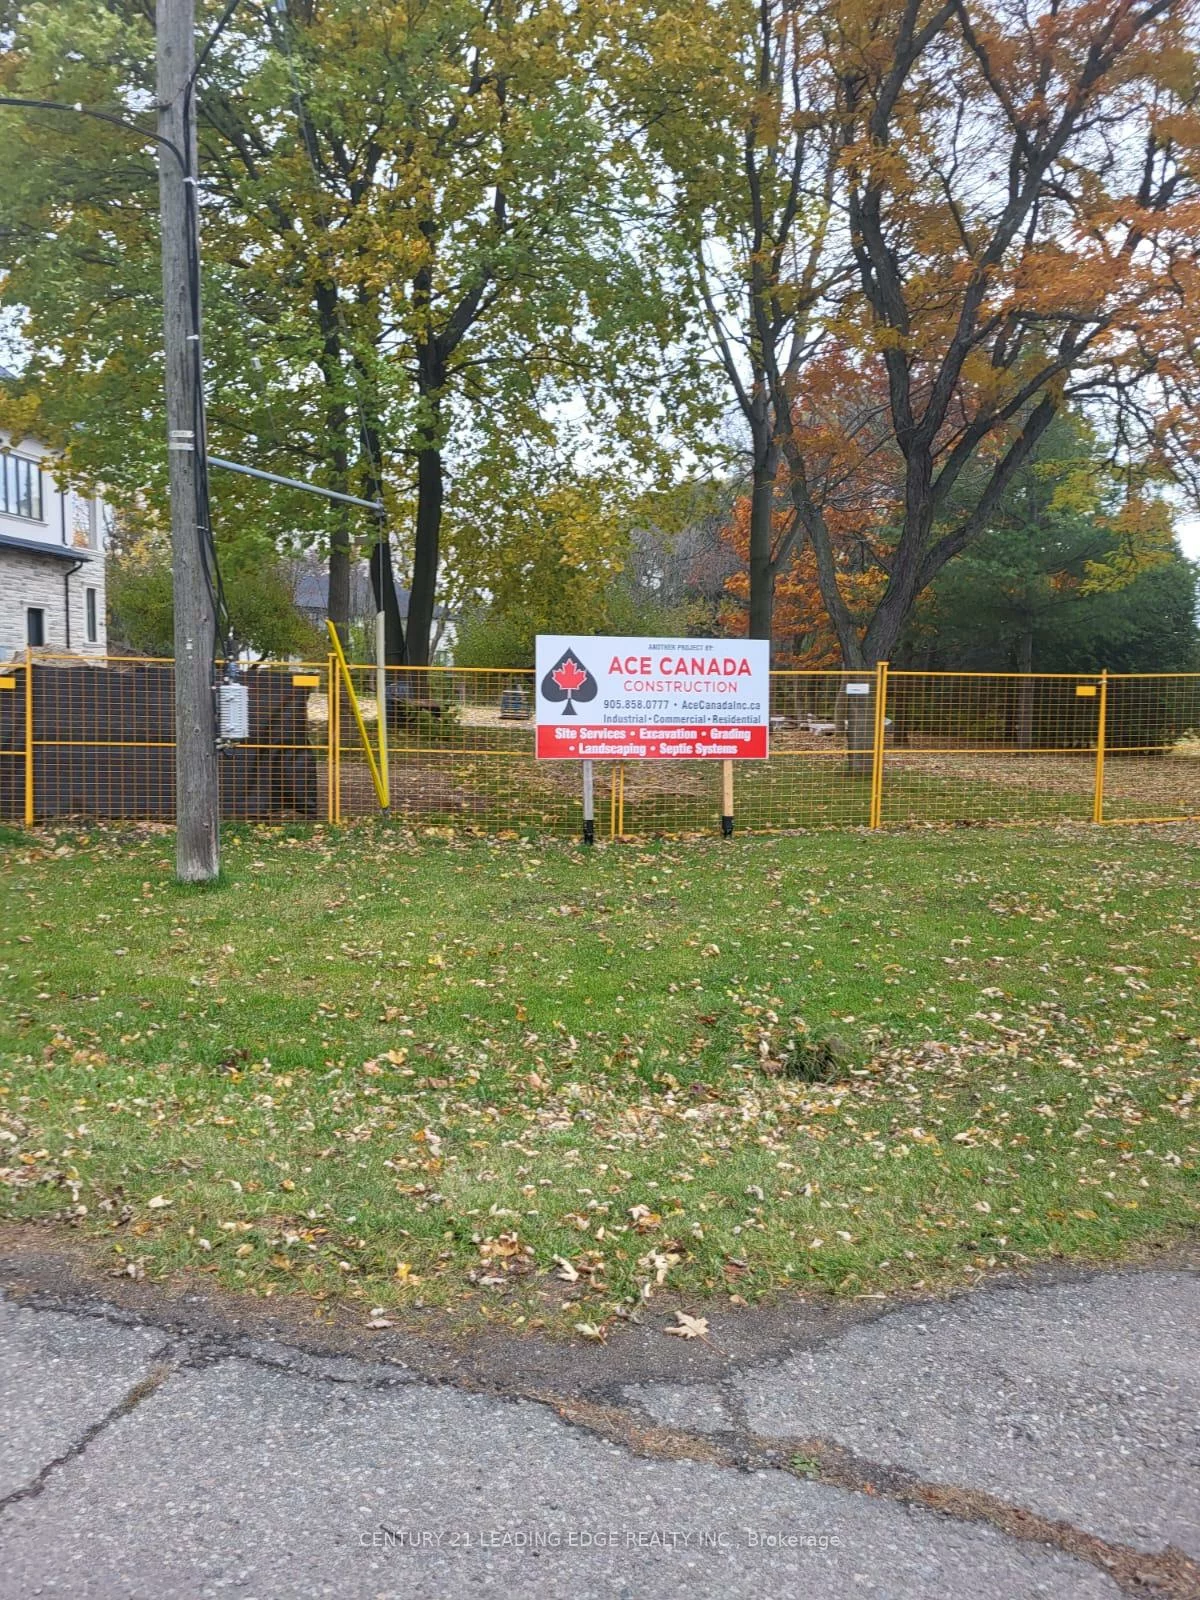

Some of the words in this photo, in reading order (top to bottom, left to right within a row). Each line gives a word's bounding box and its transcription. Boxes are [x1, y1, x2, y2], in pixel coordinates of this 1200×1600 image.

[608, 656, 652, 675] ACE
[659, 657, 752, 676] CANADA
[623, 680, 738, 693] CONSTRUCTION
[603, 699, 669, 709] 905.858.0777
[681, 700, 761, 710] AceCanadaInc.ca
[603, 714, 647, 724] Industrial
[653, 714, 706, 724] Commercial
[712, 714, 761, 724] Residential
[555, 727, 577, 739] Site
[579, 727, 626, 739] Services
[639, 728, 698, 739] Excavation
[710, 728, 752, 741] Grading
[579, 743, 647, 756] Landscaping
[659, 743, 693, 756] Septic
[695, 743, 738, 756] Systems
